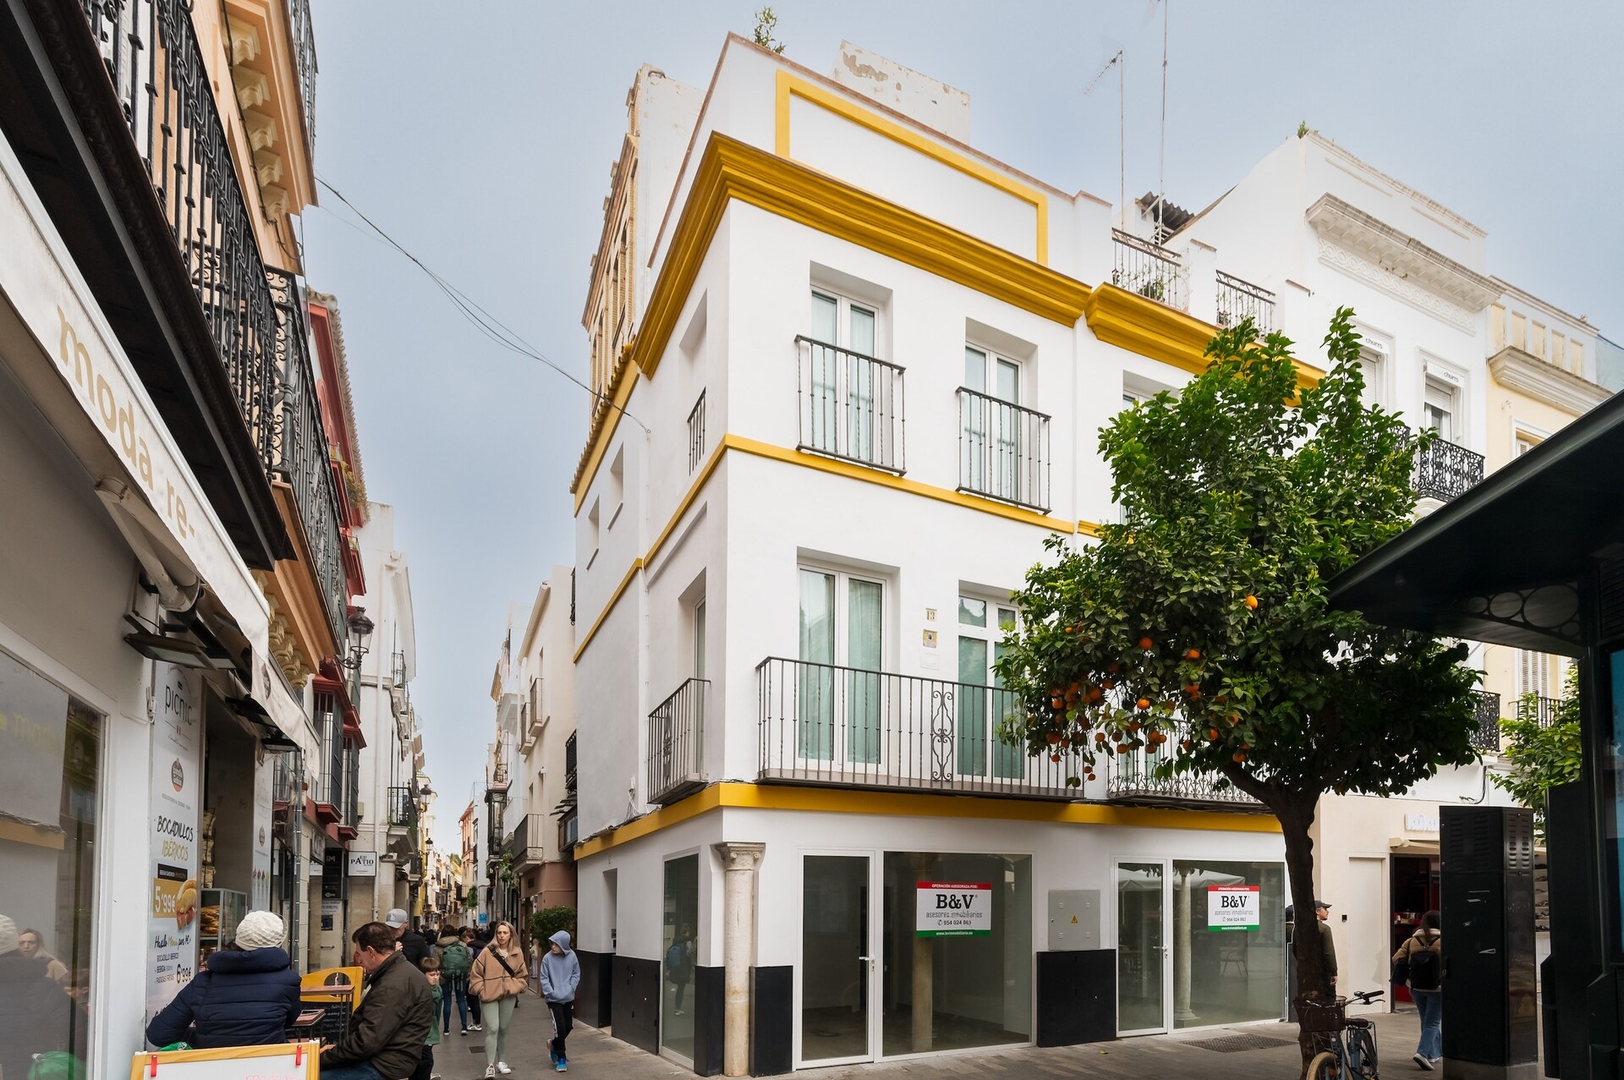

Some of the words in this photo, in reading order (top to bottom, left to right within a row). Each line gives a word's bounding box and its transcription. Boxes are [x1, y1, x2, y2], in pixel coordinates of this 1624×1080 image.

[57, 304, 154, 491] moda
[166, 477, 195, 539] re-
[157, 815, 194, 843] BOCADILLOS
[350, 857, 374, 865] PATIO
[936, 894, 974, 909] B&V
[1221, 895, 1247, 908] B&V
